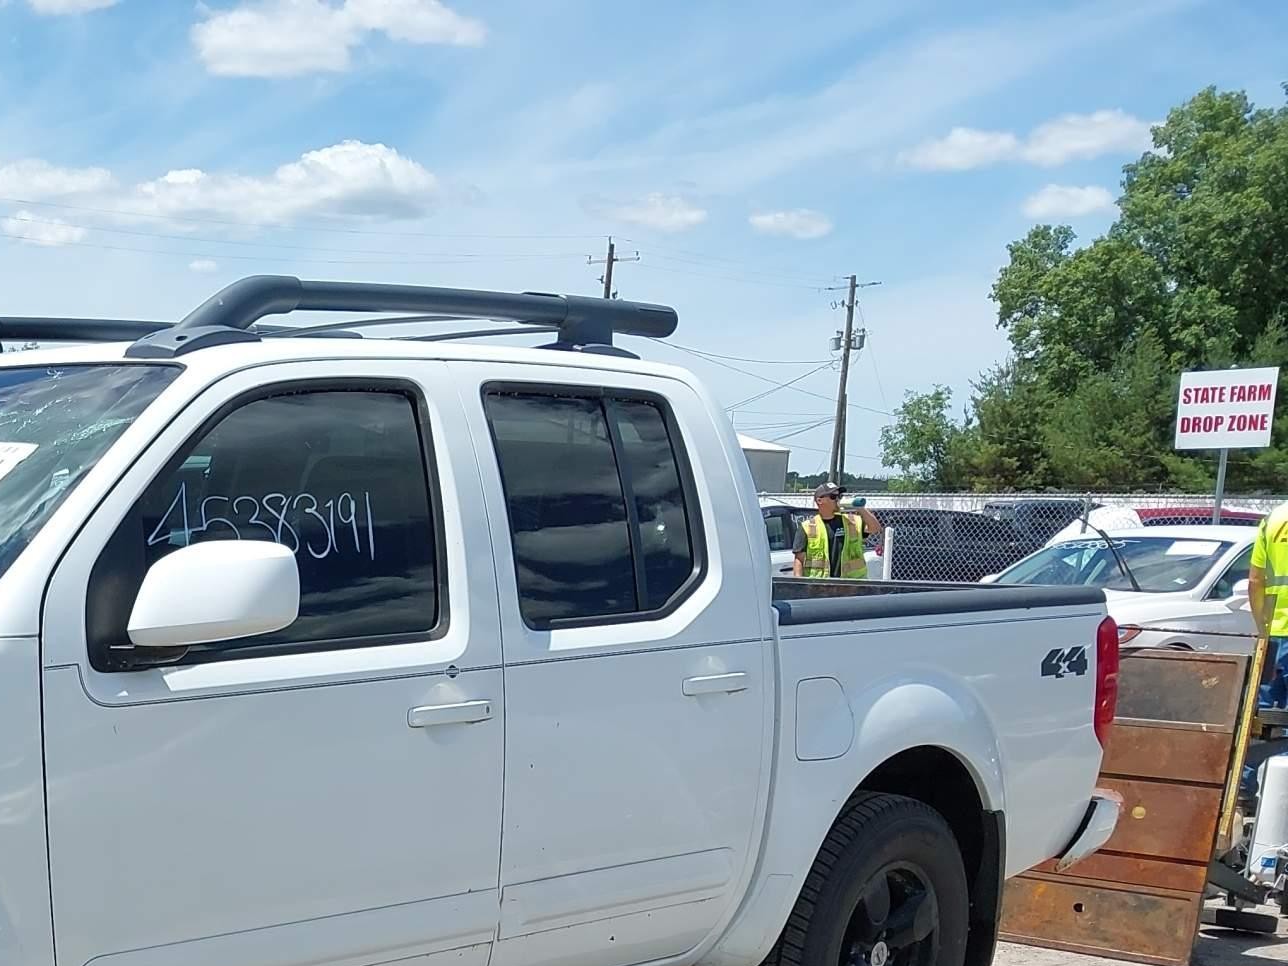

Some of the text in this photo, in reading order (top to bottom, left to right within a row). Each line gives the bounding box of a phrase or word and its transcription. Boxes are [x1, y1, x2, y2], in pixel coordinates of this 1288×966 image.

[1182, 384, 1273, 405] STATE FARM
[1180, 414, 1269, 433] DROP ZONE
